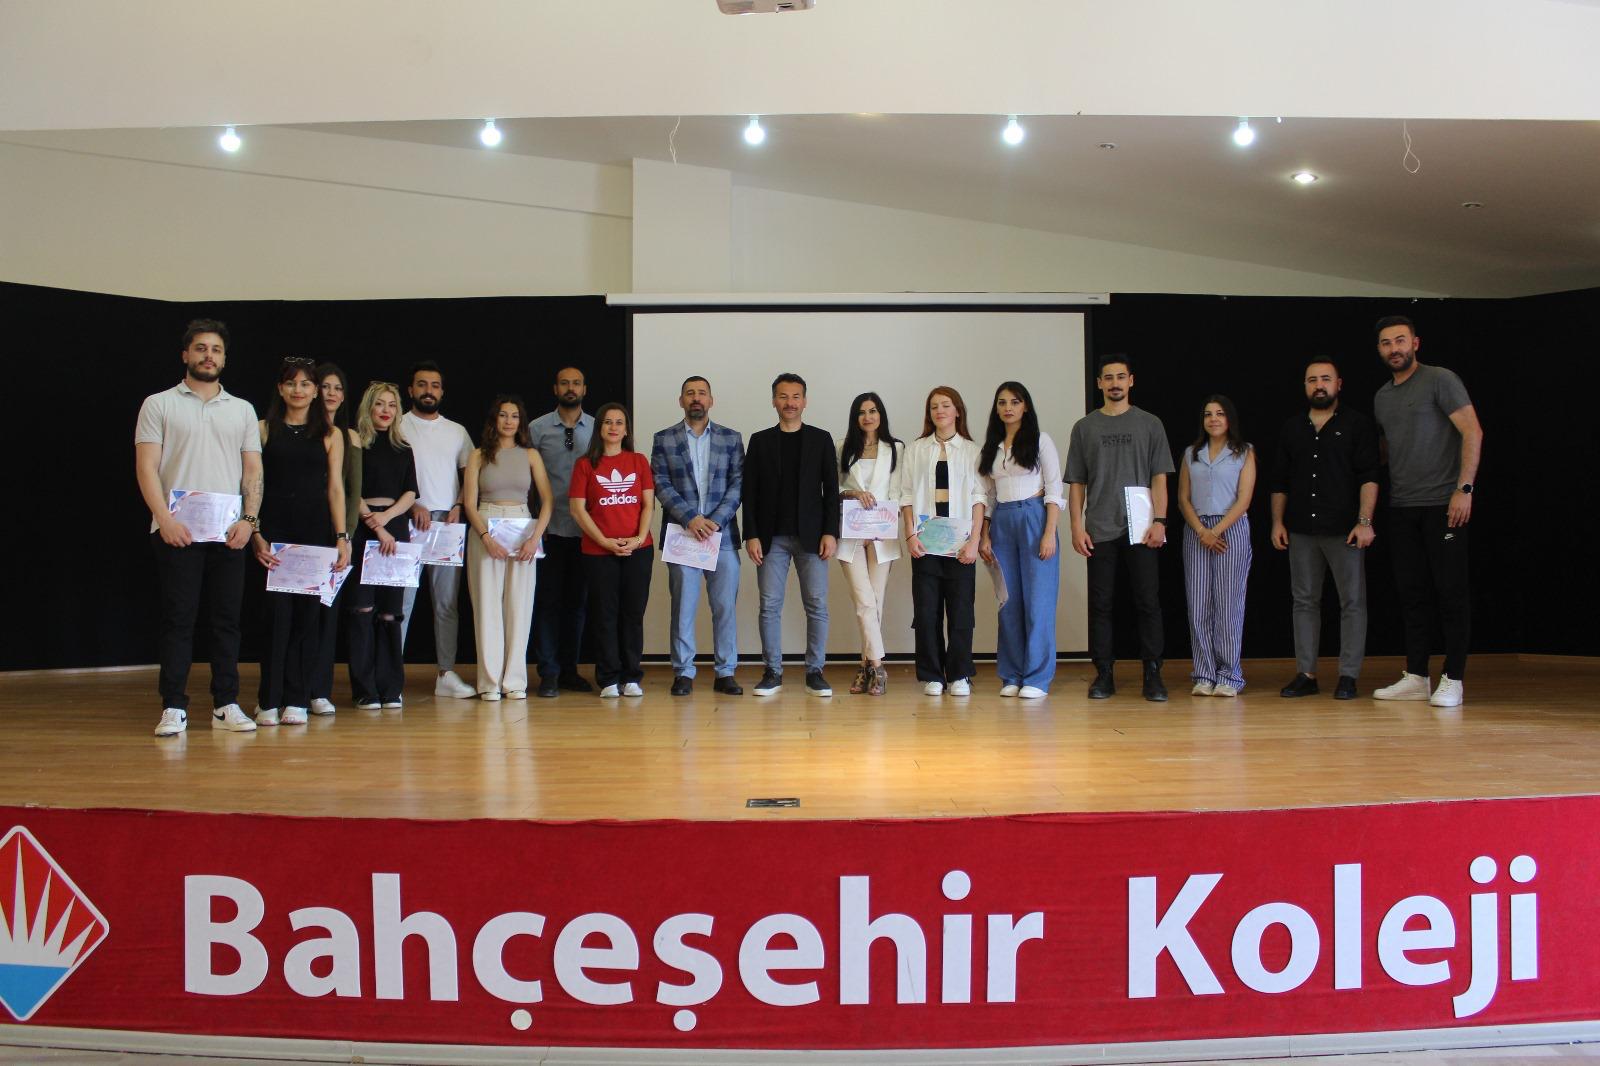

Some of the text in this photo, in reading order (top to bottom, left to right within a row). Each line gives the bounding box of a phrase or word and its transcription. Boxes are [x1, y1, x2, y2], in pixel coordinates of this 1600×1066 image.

[599, 493, 637, 506] adidas
[184, 855, 1537, 1032] Bahçeşehir Koleji
